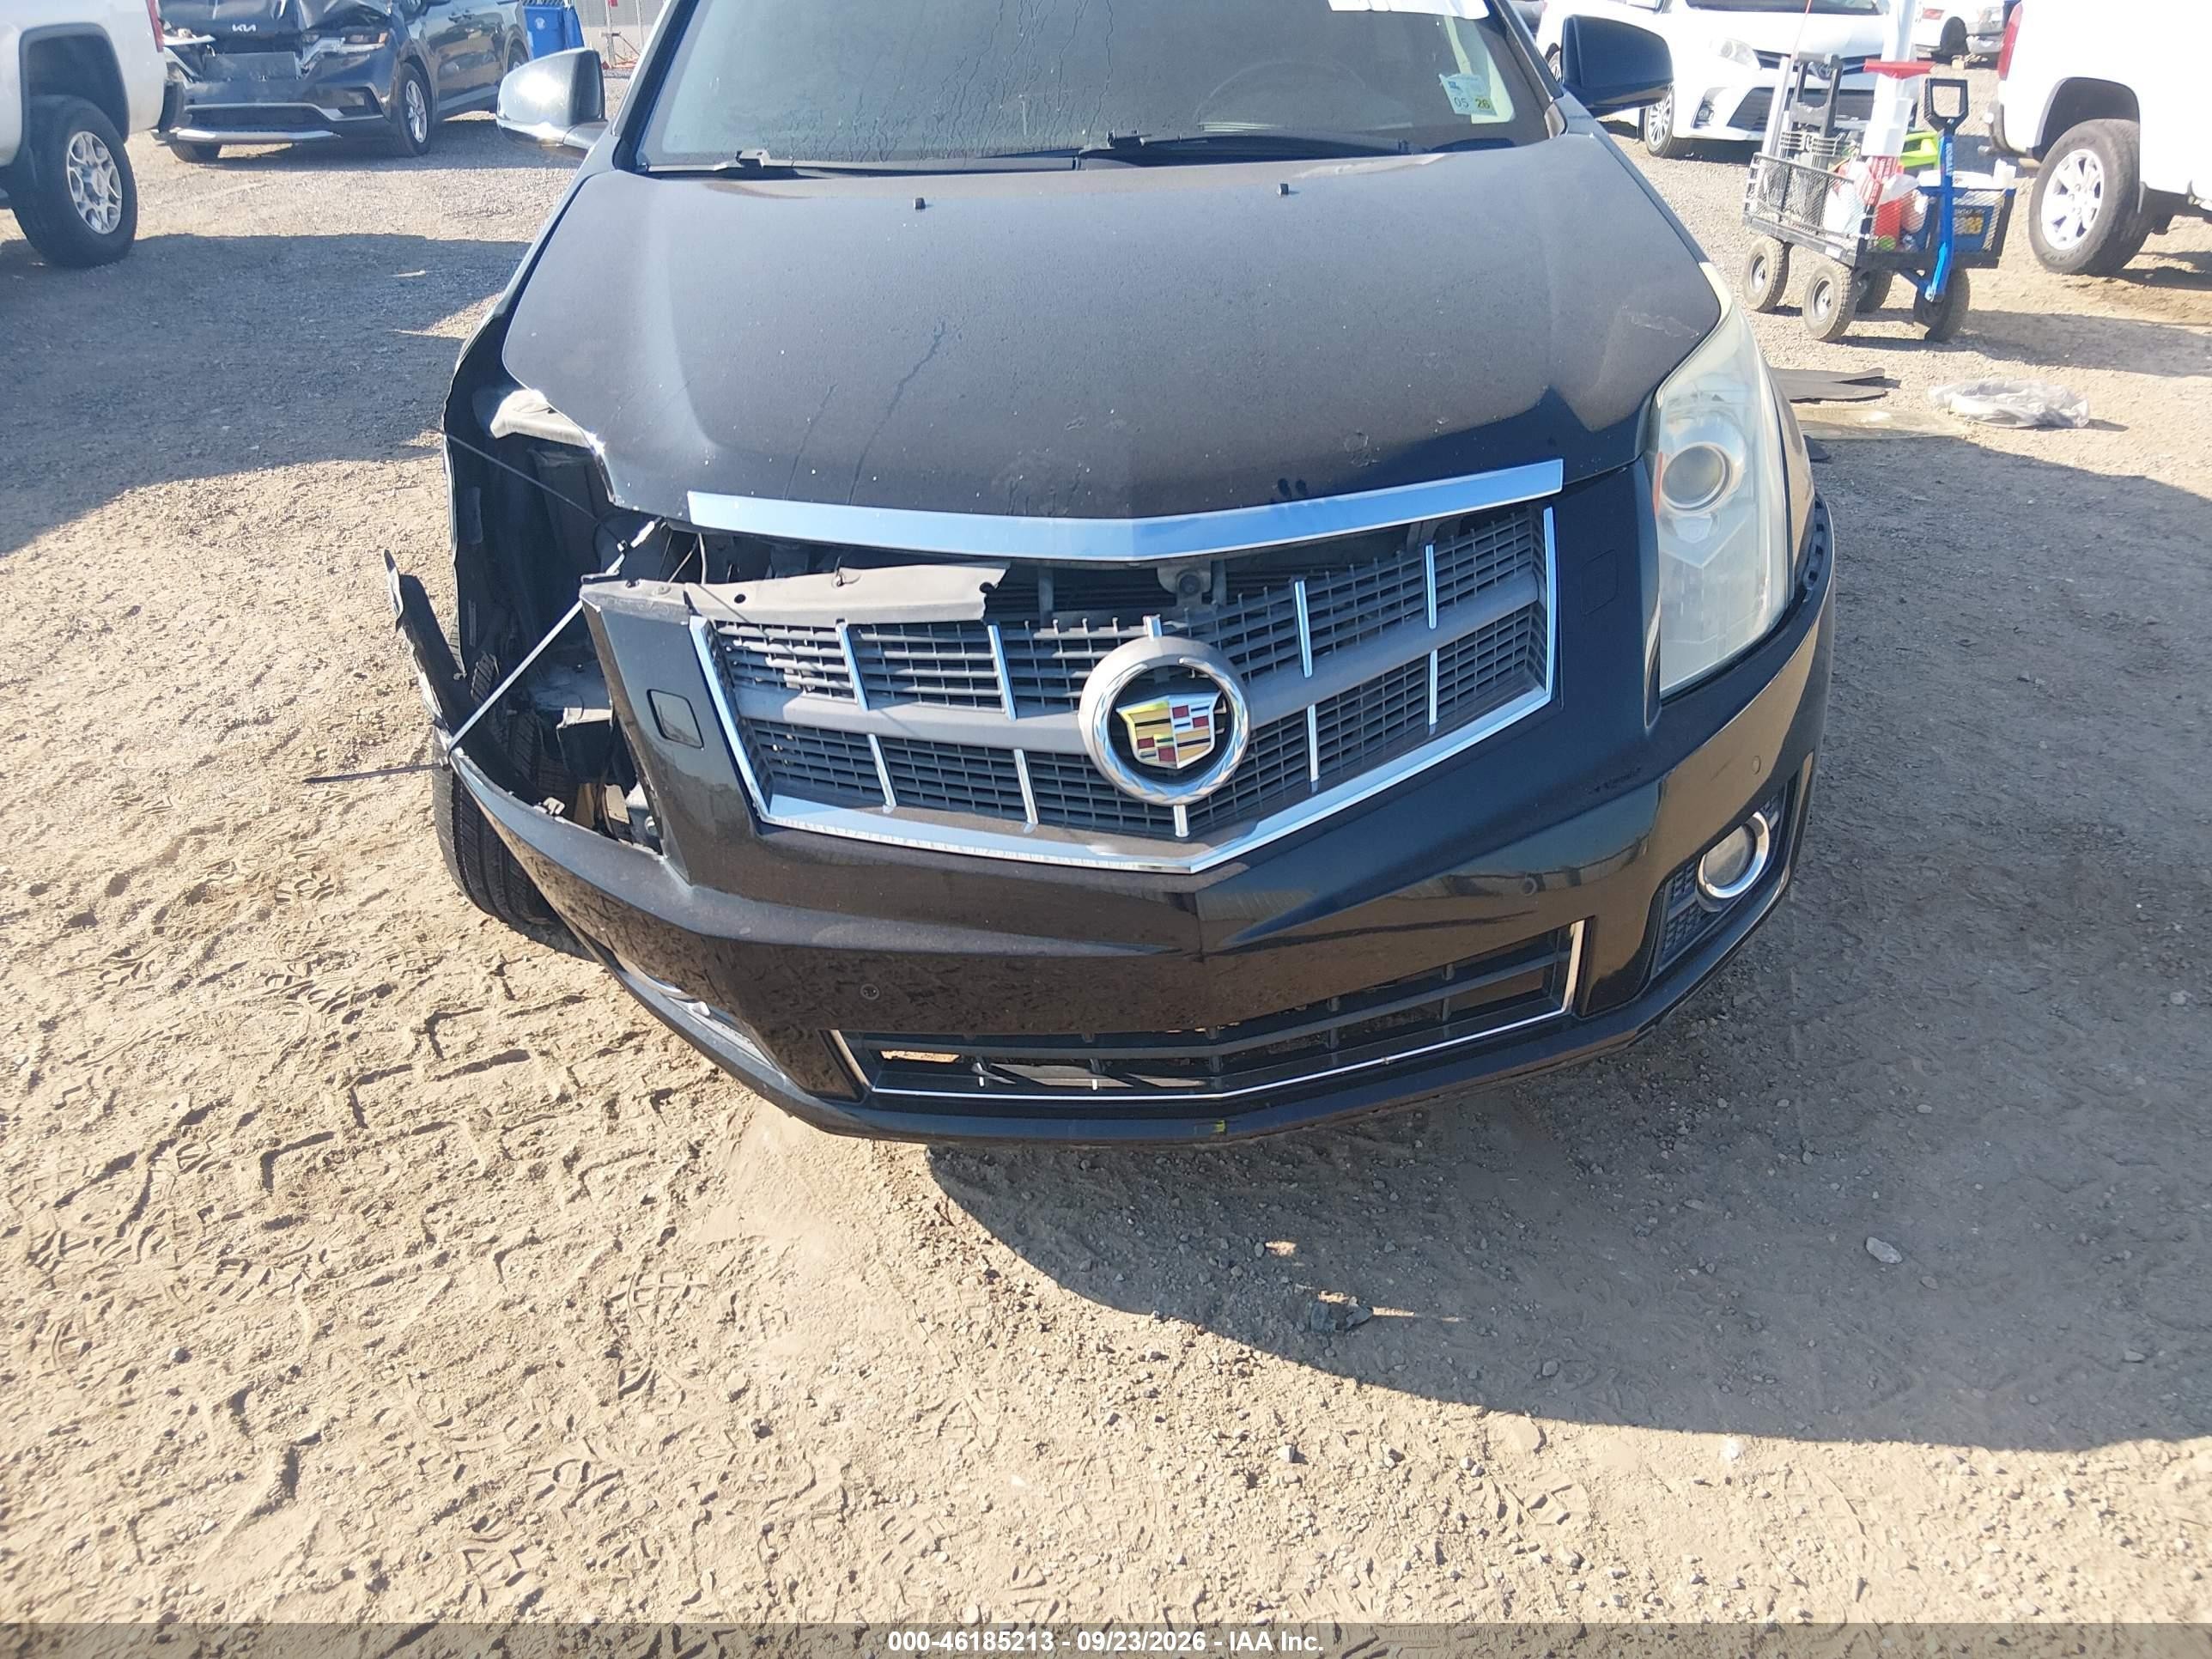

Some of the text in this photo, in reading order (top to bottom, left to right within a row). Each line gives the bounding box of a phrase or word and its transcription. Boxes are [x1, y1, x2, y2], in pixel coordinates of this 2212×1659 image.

[232, 23, 257, 33] KIA
[1454, 96, 1491, 109] 05 26
